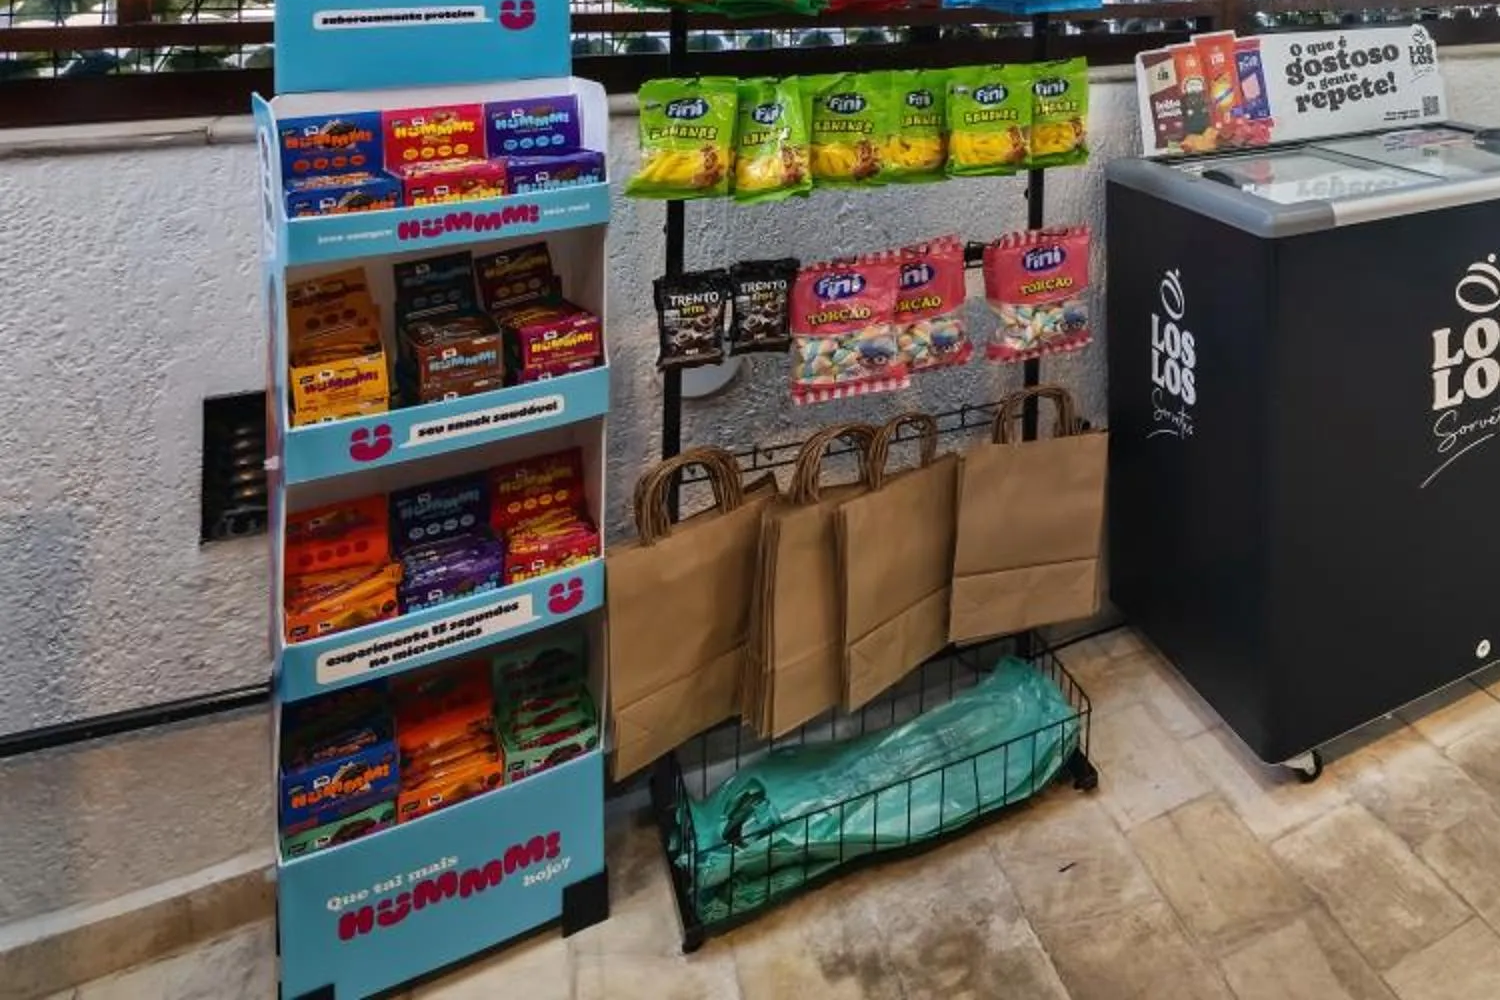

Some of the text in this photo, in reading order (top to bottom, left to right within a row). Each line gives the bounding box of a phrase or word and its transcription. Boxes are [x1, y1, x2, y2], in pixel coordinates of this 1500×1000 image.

[1285, 44, 1399, 86] gostoso
[1289, 35, 1348, 57] O que é
[1295, 71, 1398, 114] repete!
[1307, 72, 1359, 92] a gente
[670, 291, 720, 307] TRENTO
[740, 280, 787, 293] TRENTO
[1151, 312, 1195, 369] LOS
[1151, 347, 1196, 406] LOS
[417, 400, 558, 437] seu snack saudável
[326, 601, 520, 667] experimente 15 segundos
[369, 627, 483, 669] no microondas
[327, 855, 459, 911] Que tal mais
[523, 856, 572, 887] hoje?
